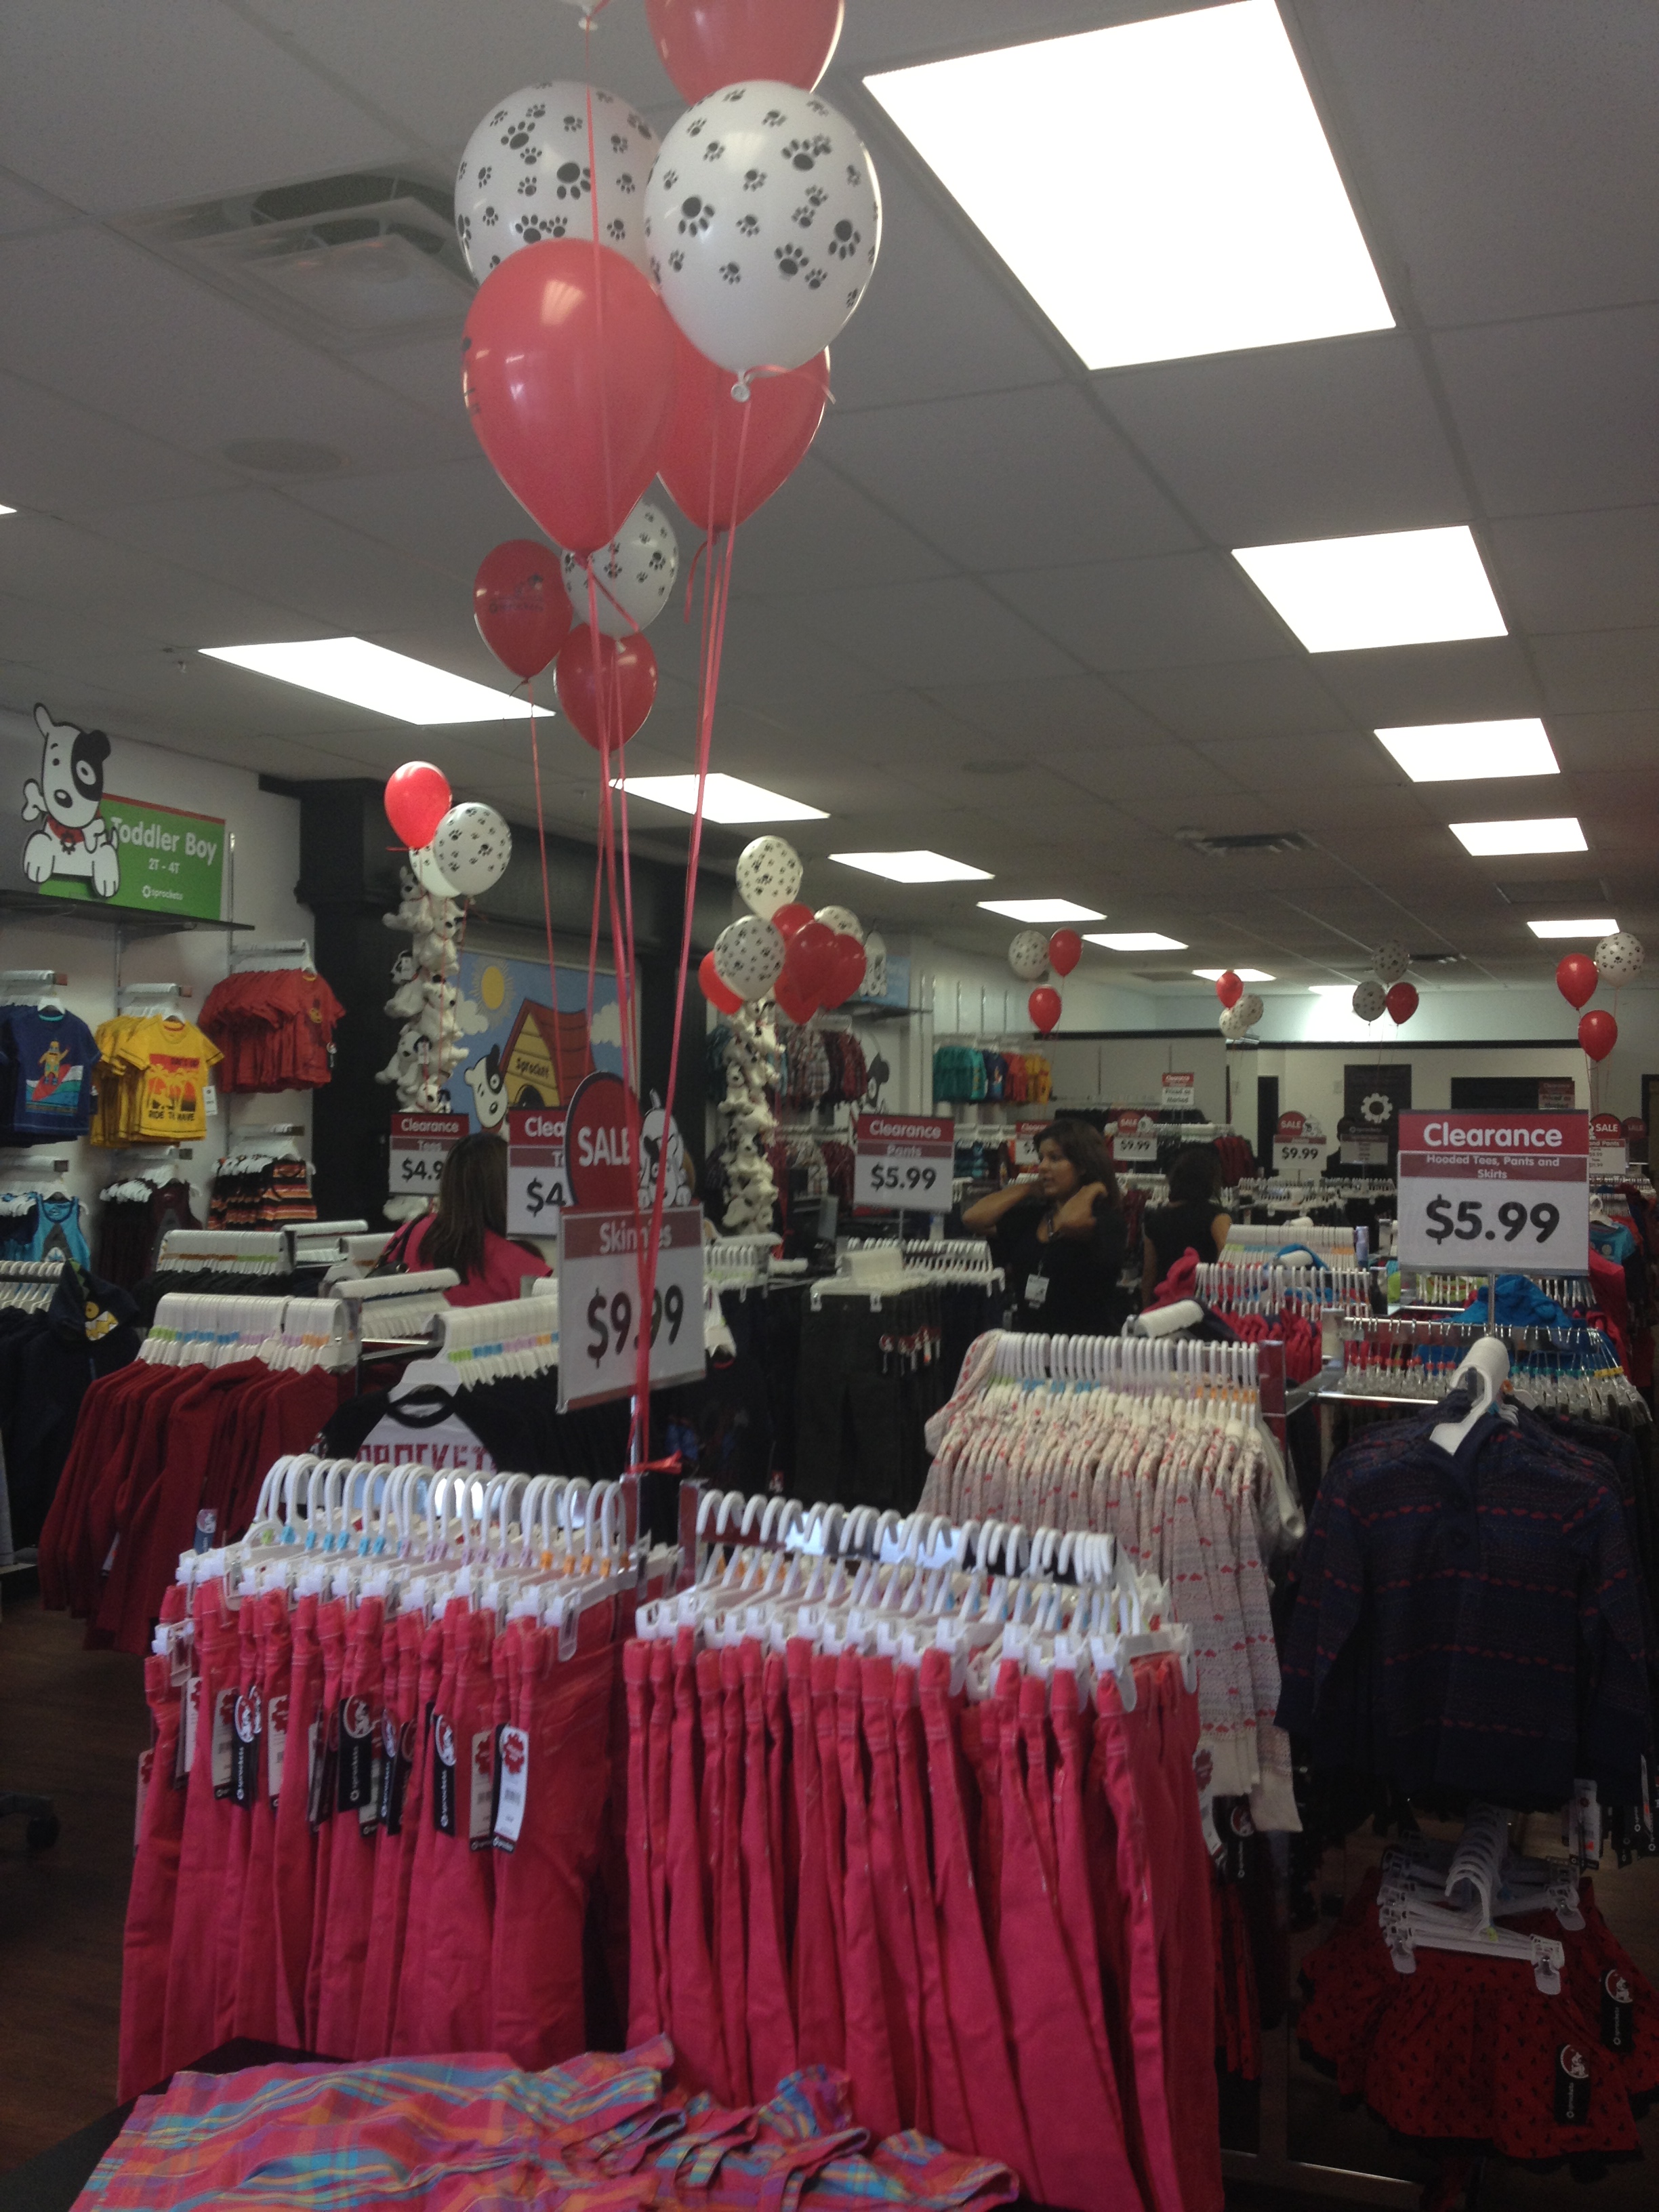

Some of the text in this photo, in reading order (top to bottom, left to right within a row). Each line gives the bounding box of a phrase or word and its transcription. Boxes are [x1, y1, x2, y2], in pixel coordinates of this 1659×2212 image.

[110, 817, 217, 866] Toddler Boy
[148, 857, 160, 870] 2T
[168, 862, 180, 874] 4T
[401, 1118, 459, 1133] Clearance
[869, 1119, 942, 1140] Clearance
[1281, 1120, 1301, 1130] SALE
[1595, 1124, 1618, 1132] SALE
[1424, 1122, 1563, 1147] Clearance
[577, 1125, 632, 1168] SALE
[886, 1144, 922, 1158] Pants
[1120, 1139, 1150, 1151] $9.99
[1282, 1147, 1318, 1160] $9.99
[1426, 1153, 1559, 1167] Hooded Tees, Pants and
[401, 1156, 444, 1183] $4.9
[870, 1162, 937, 1193] $5.99
[1477, 1169, 1507, 1179] Skirts
[1425, 1193, 1560, 1245] $5.99
[599, 1220, 672, 1254] Skinnes
